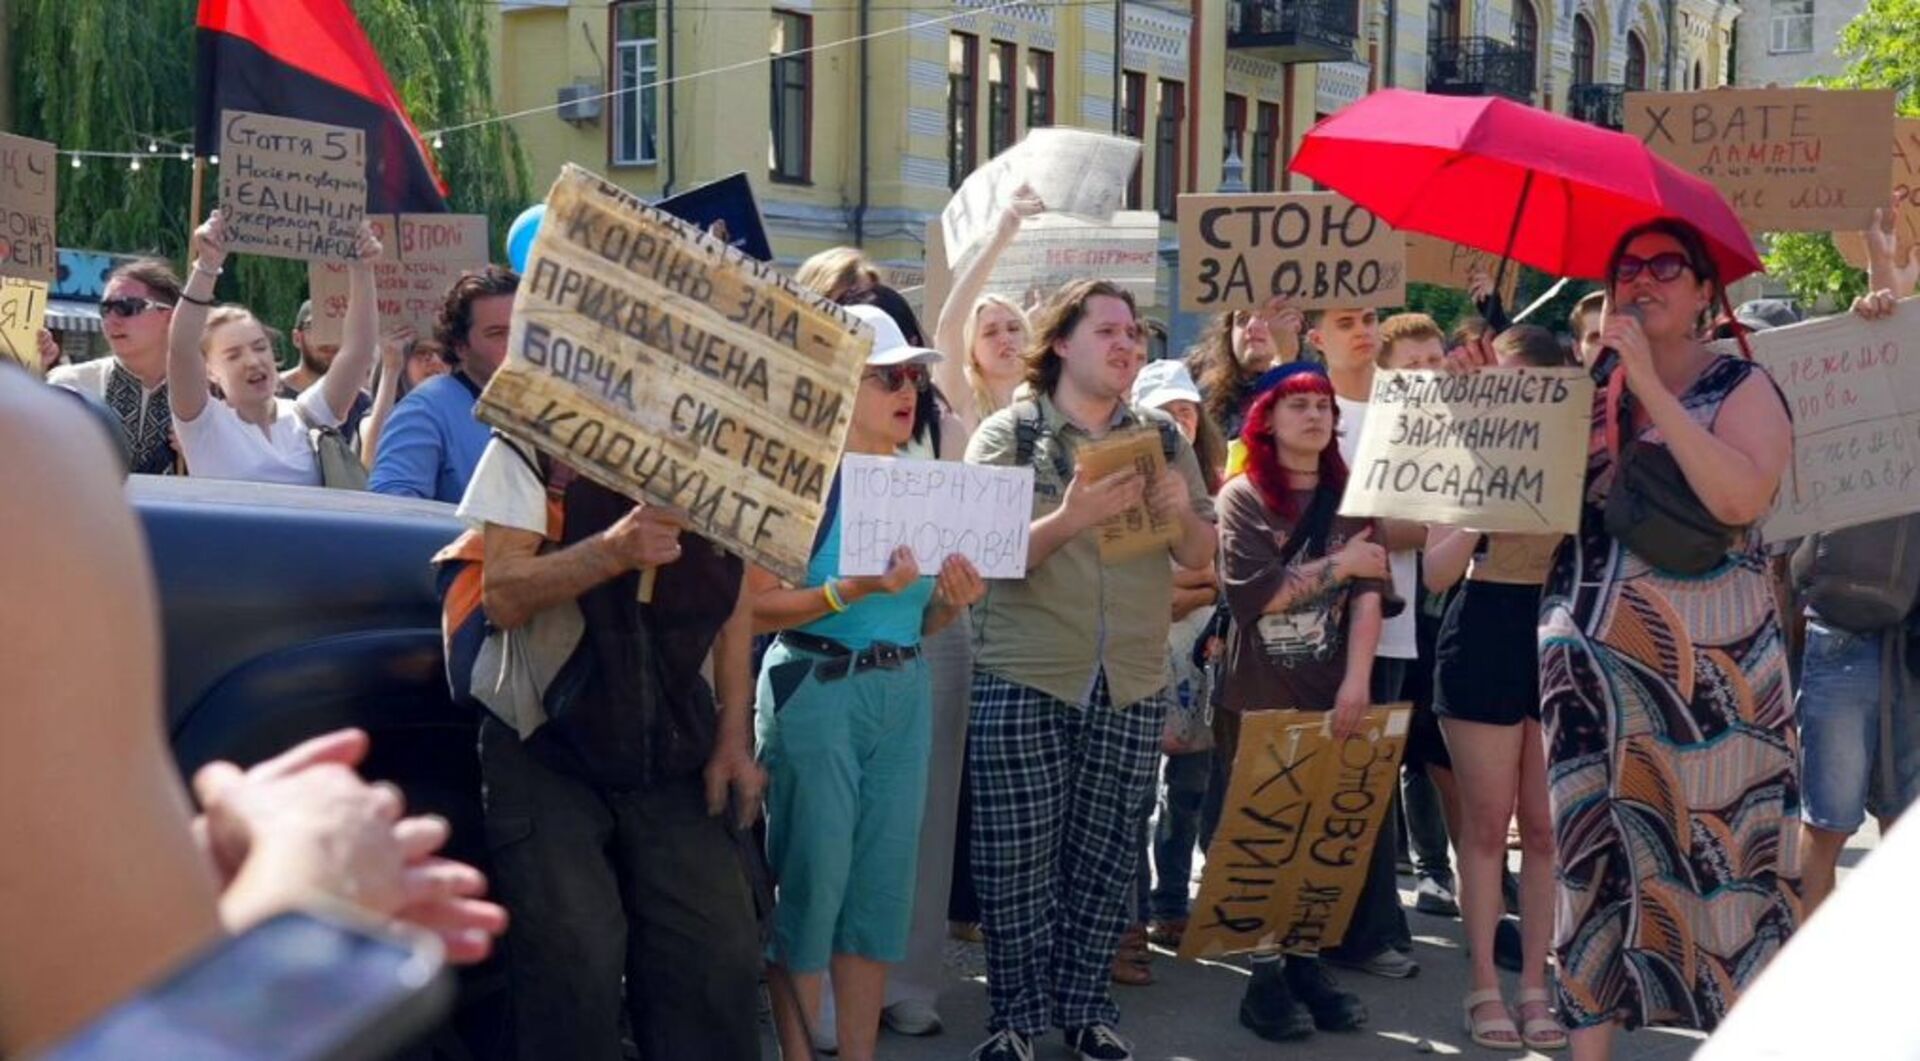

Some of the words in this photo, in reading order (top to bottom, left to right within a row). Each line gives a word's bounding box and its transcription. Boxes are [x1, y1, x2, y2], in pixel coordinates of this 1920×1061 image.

[226, 114, 313, 155] Стаття
[237, 182, 364, 222] ЄДИНИМ
[297, 231, 359, 259] НАРОД
[1199, 203, 1377, 248] СТОЮ
[567, 203, 711, 300] КОРІНЬ
[727, 285, 799, 350] ЗЛА
[1196, 253, 1255, 303] ЗА
[523, 322, 637, 410] БОРЧА
[671, 392, 825, 503] СИСТЕМА
[1390, 413, 1541, 451] ЗАЙМАНИМ
[852, 467, 1026, 508] ПОВЕРНУТИ
[1365, 459, 1543, 506] ПОСАДАМ
